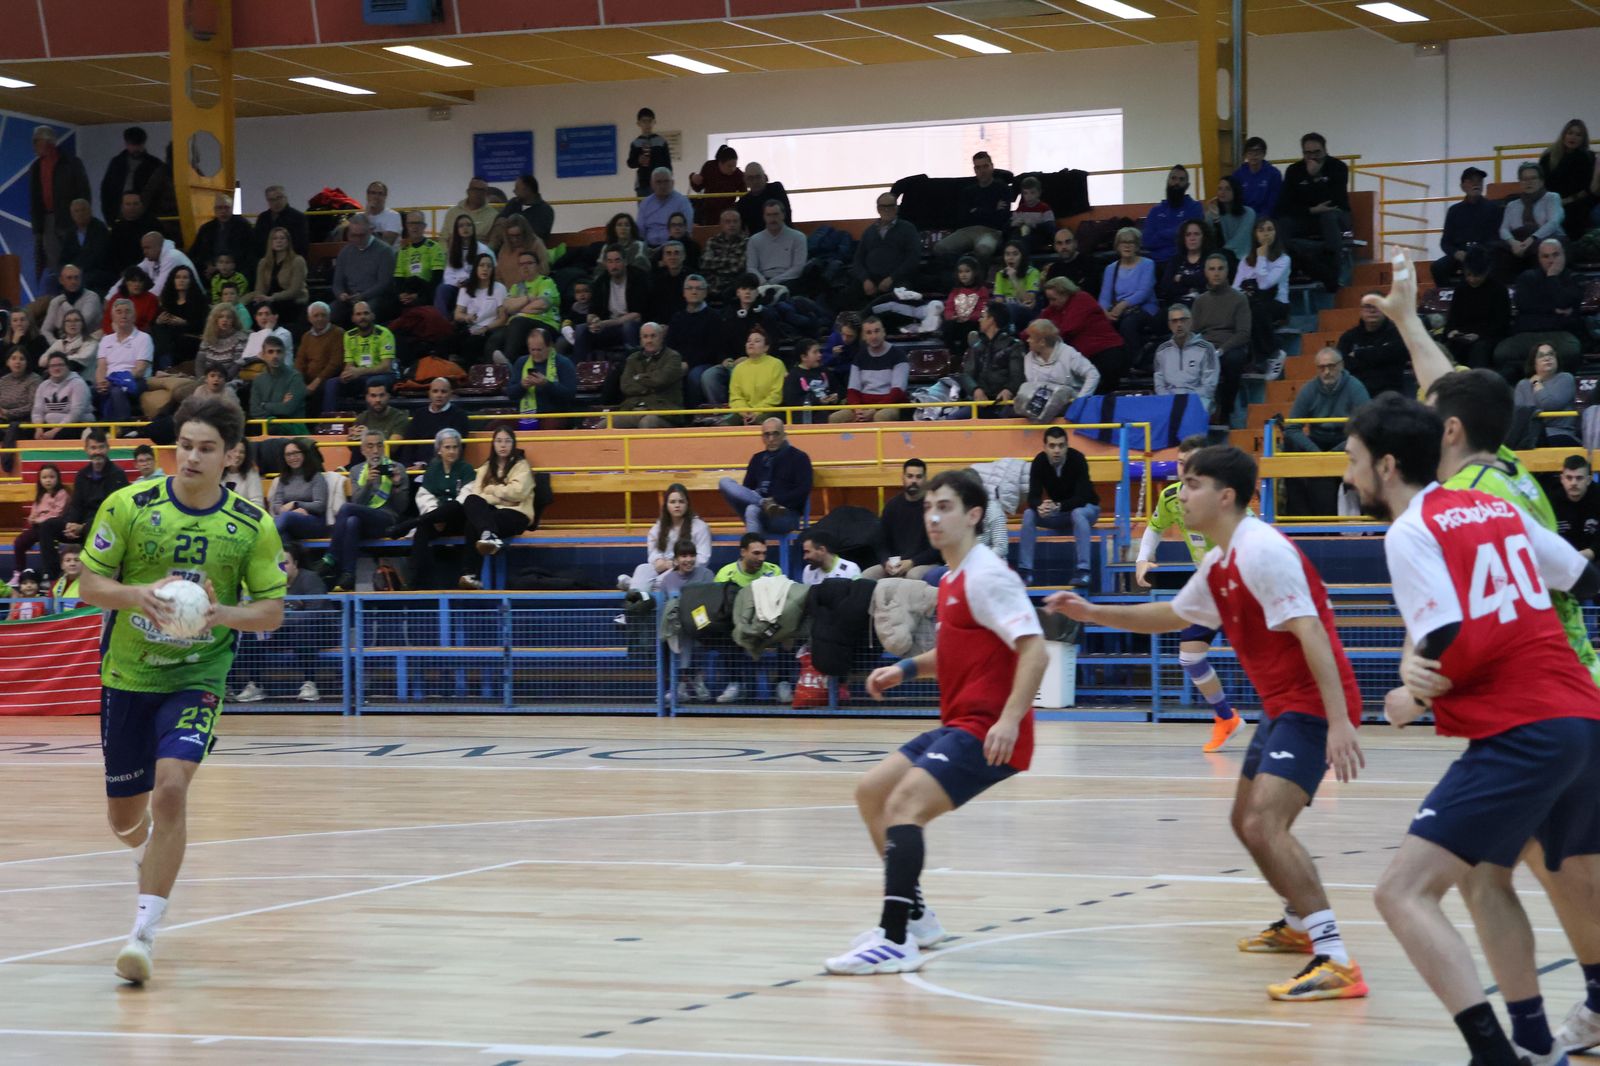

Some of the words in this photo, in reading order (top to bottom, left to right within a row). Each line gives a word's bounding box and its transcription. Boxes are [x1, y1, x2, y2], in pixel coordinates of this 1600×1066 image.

[174, 534, 209, 565] 23
[1468, 533, 1553, 624] 40
[175, 706, 214, 734] 23
[210, 742, 888, 762] ZAMOR
